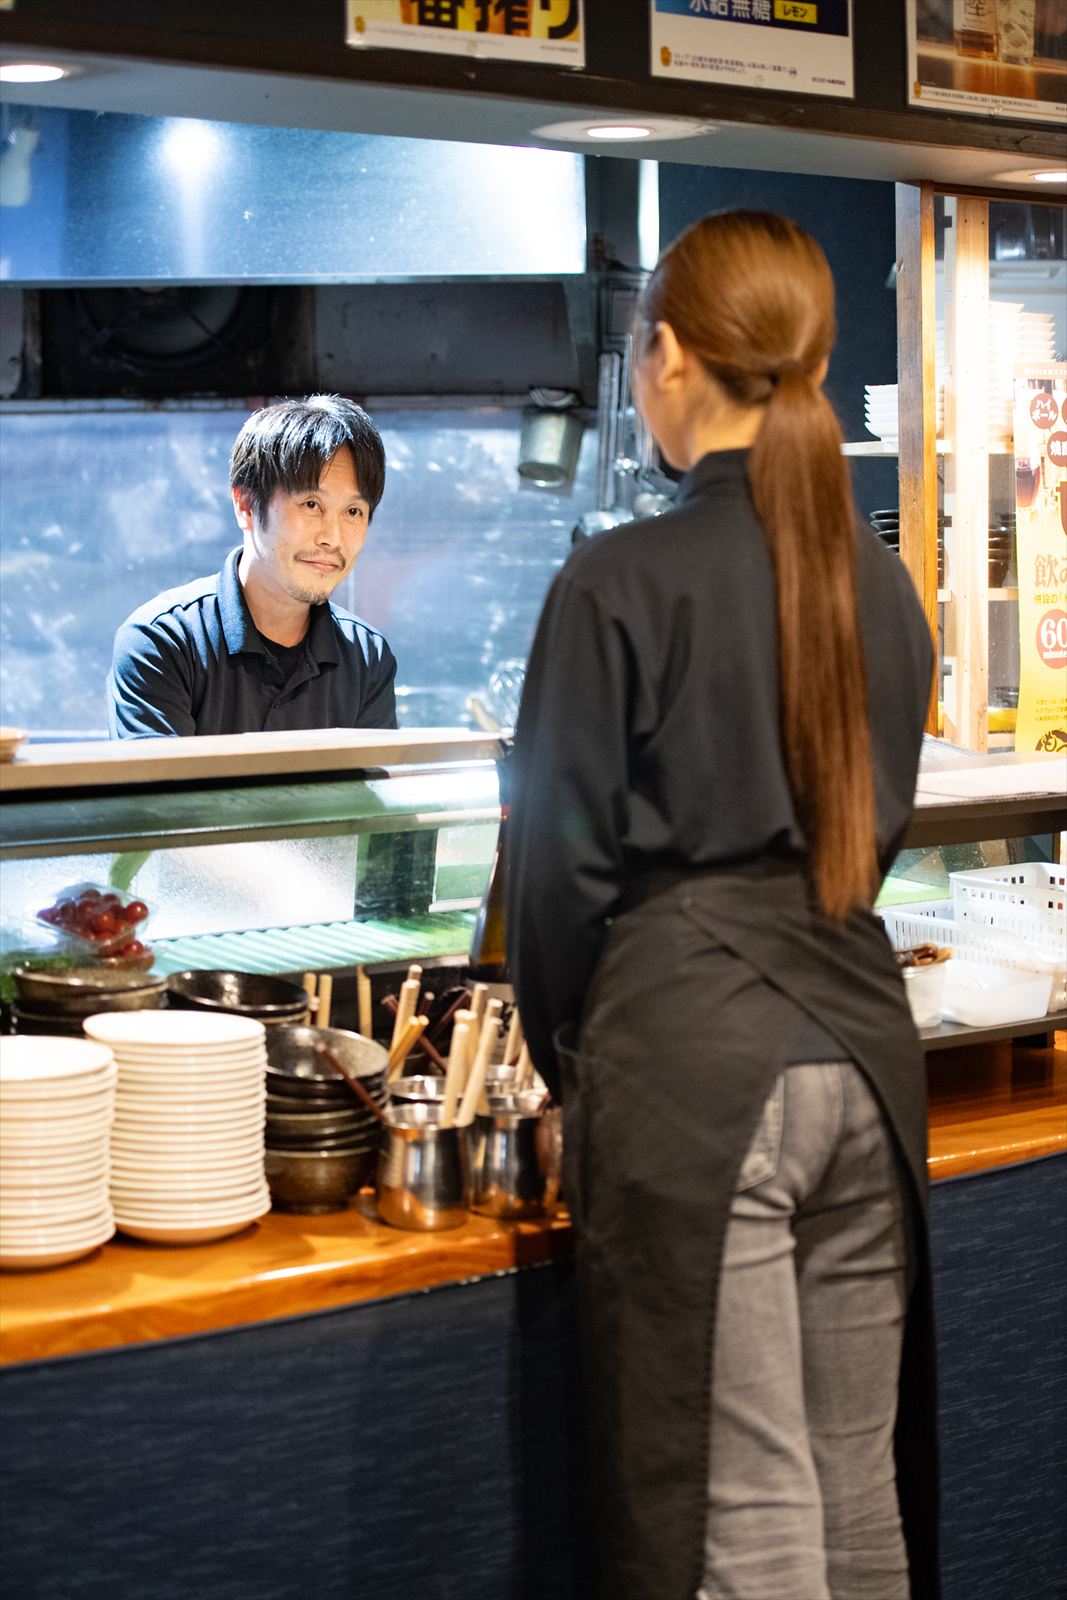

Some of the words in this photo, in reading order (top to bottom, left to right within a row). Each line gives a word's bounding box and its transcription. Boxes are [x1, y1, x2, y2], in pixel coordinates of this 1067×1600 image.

[783, 4, 808, 18] レモン
[1035, 399, 1052, 410] ハイ
[1032, 409, 1057, 421] ボール
[1041, 618, 1067, 648] 60
